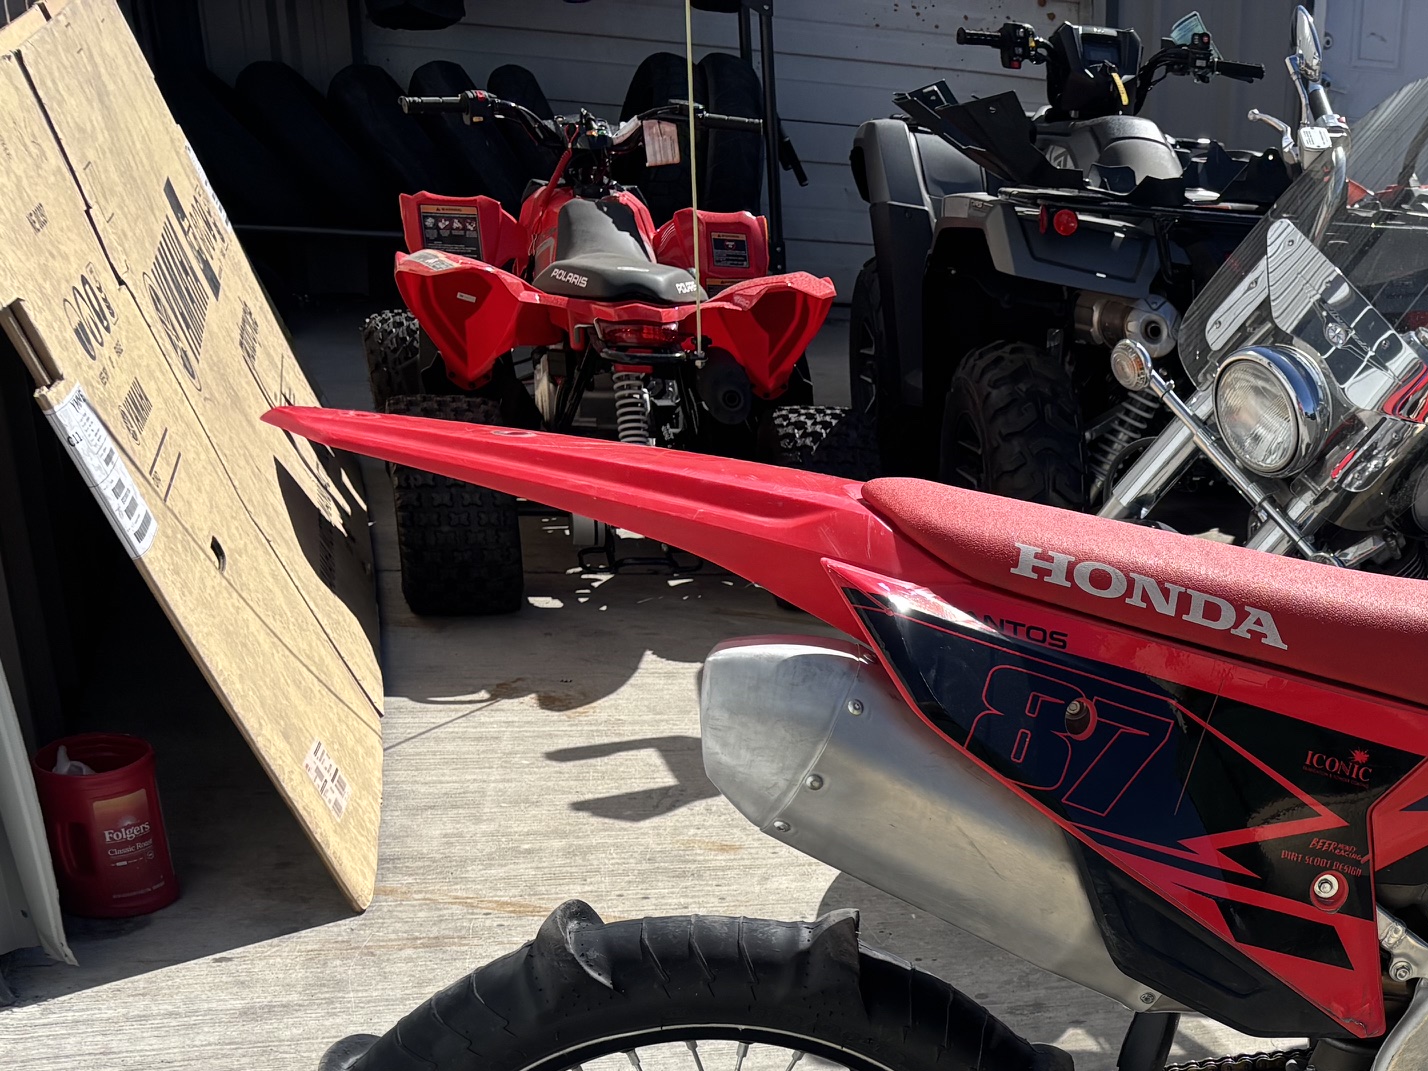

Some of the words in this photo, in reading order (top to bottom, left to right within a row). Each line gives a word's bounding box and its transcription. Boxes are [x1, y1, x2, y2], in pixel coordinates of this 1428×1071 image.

[550, 267, 590, 288] POLARIS
[1010, 542, 1288, 651] HONDA
[964, 664, 1175, 817] 87
[1304, 750, 1373, 783] ICONIC
[104, 821, 151, 843] Folgers
[107, 843, 136, 857] Classic
[136, 838, 153, 851] Roast
[1309, 837, 1338, 853] BEER
